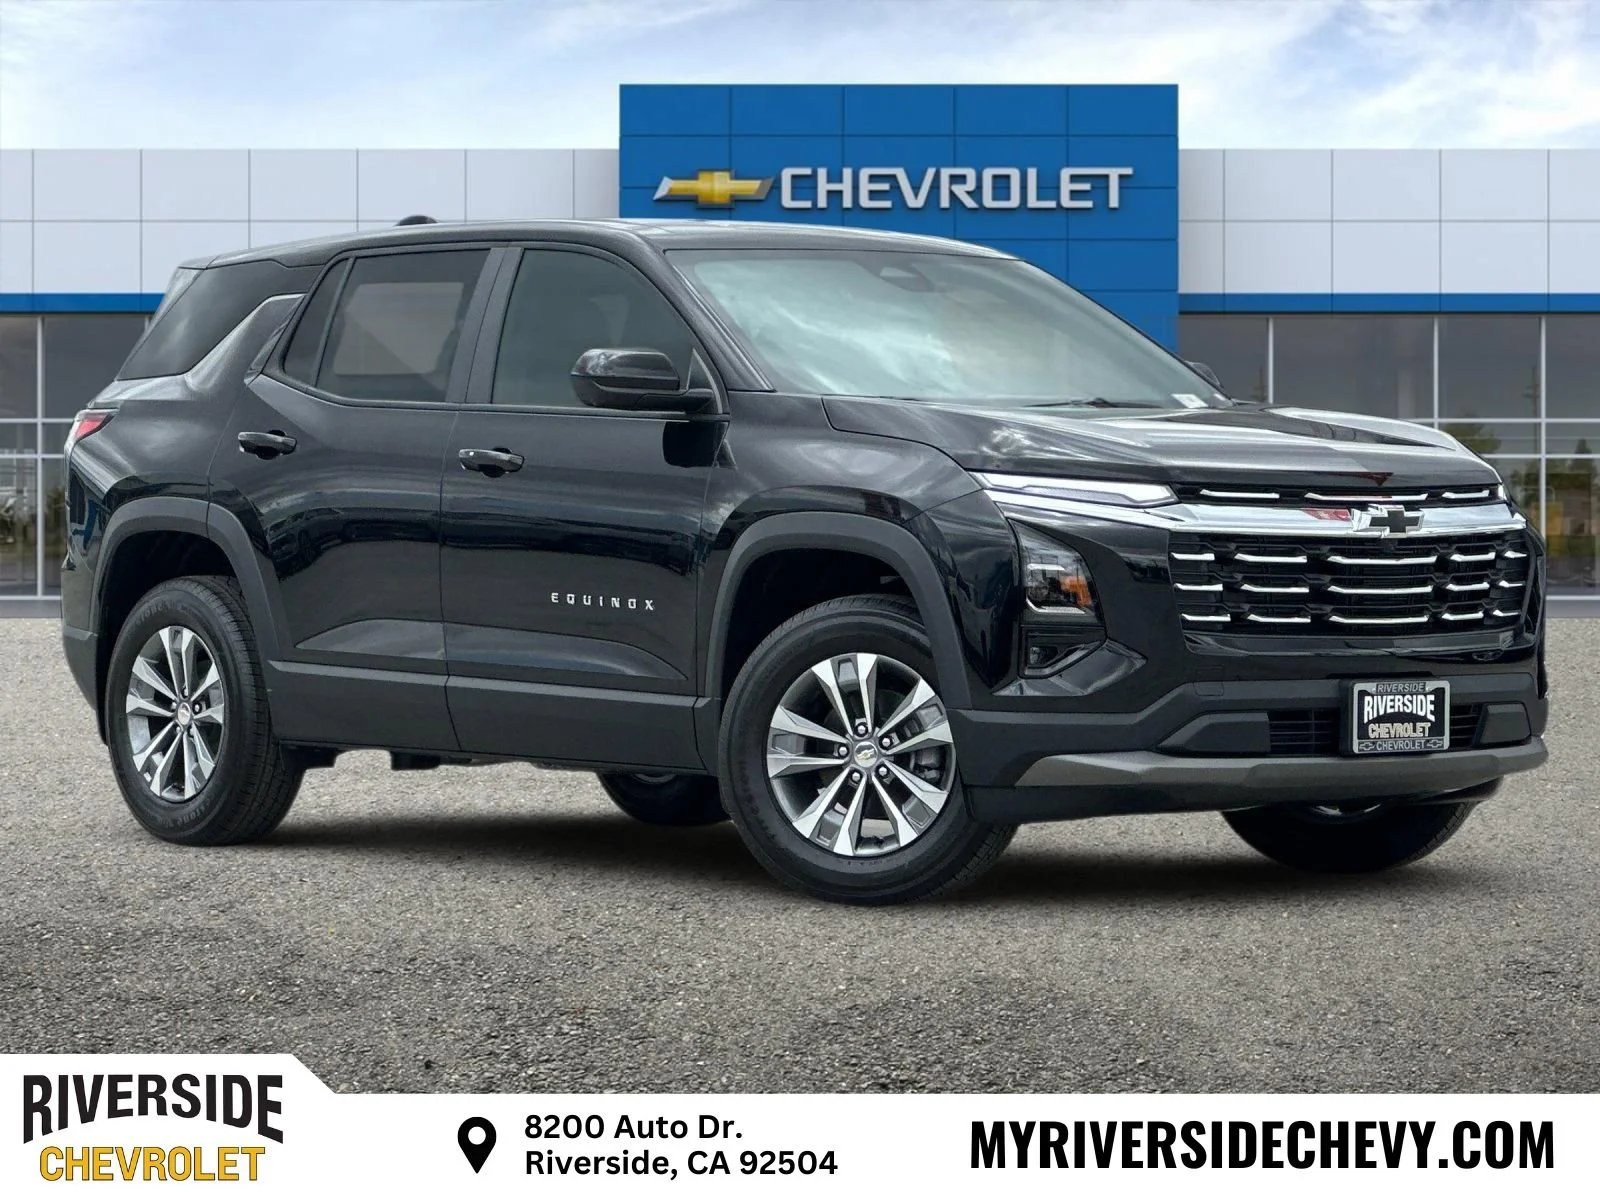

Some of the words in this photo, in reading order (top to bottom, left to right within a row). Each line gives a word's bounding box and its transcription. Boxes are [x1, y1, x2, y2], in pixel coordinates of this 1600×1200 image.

[781, 167, 1134, 208] CHEVROLET
[550, 592, 654, 611] EQUINOX
[1377, 682, 1425, 693] RIVERSIDE
[1363, 694, 1436, 724] RIVERSIDE
[1368, 722, 1431, 739] CHEVROLET
[1376, 740, 1426, 751] CHEVROLET
